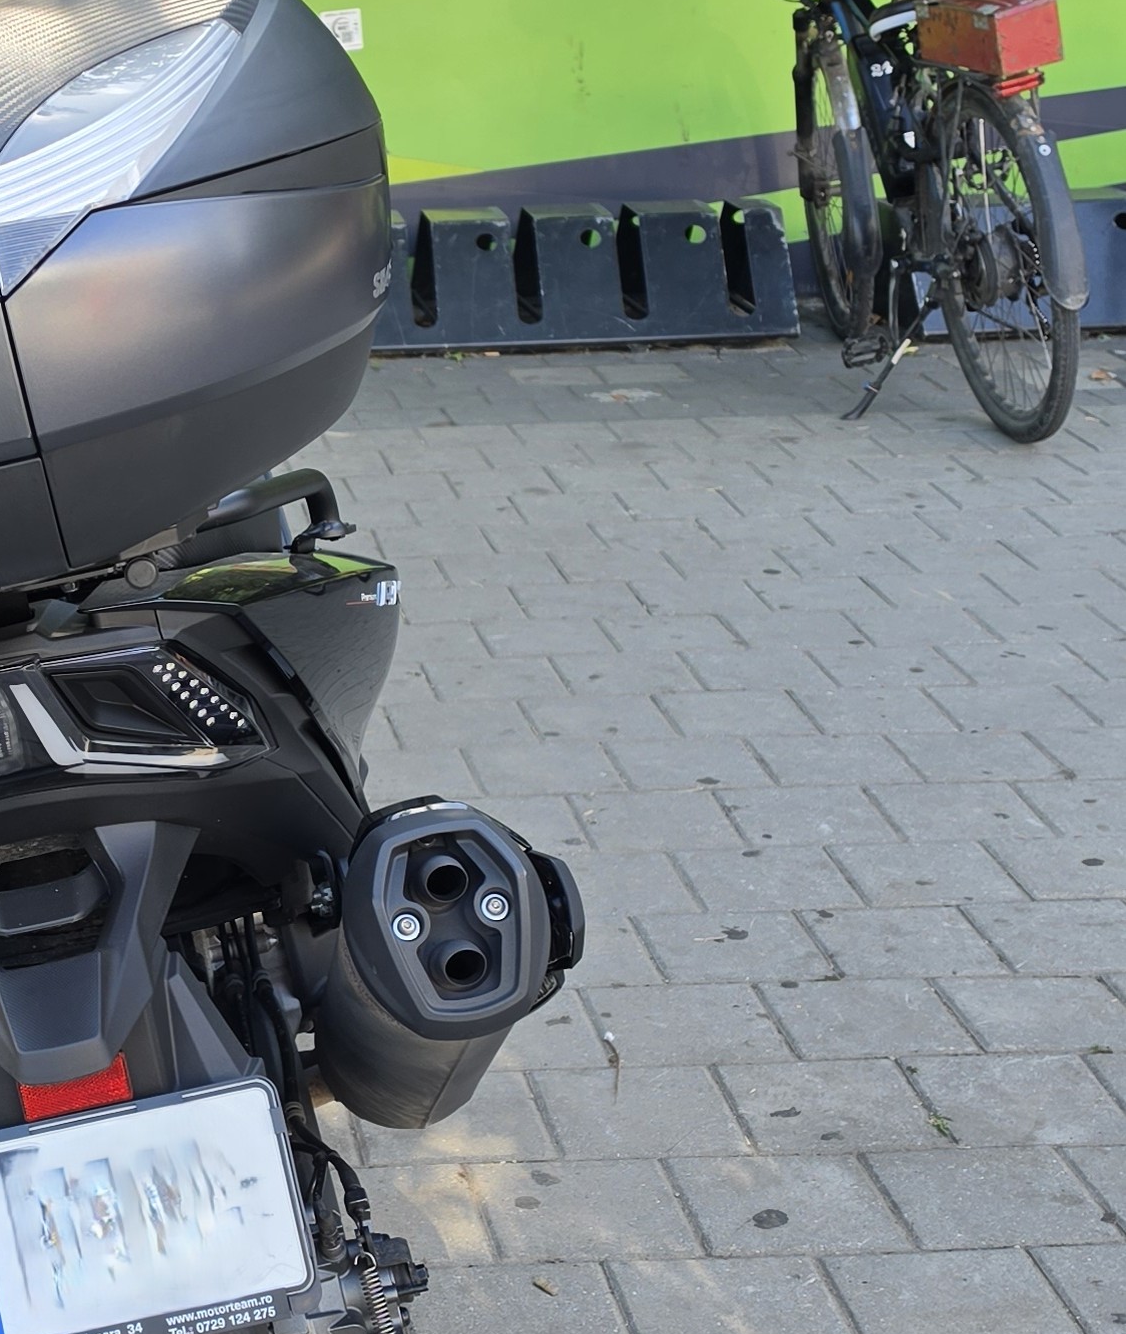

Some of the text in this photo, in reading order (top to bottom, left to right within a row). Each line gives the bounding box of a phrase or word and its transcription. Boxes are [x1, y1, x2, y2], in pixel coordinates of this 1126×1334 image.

[165, 1294, 273, 1327] www.motorteam.ro
[196, 1318, 225, 1334] 0729
[229, 1312, 251, 1327] 124
[254, 1306, 276, 1322] 275
